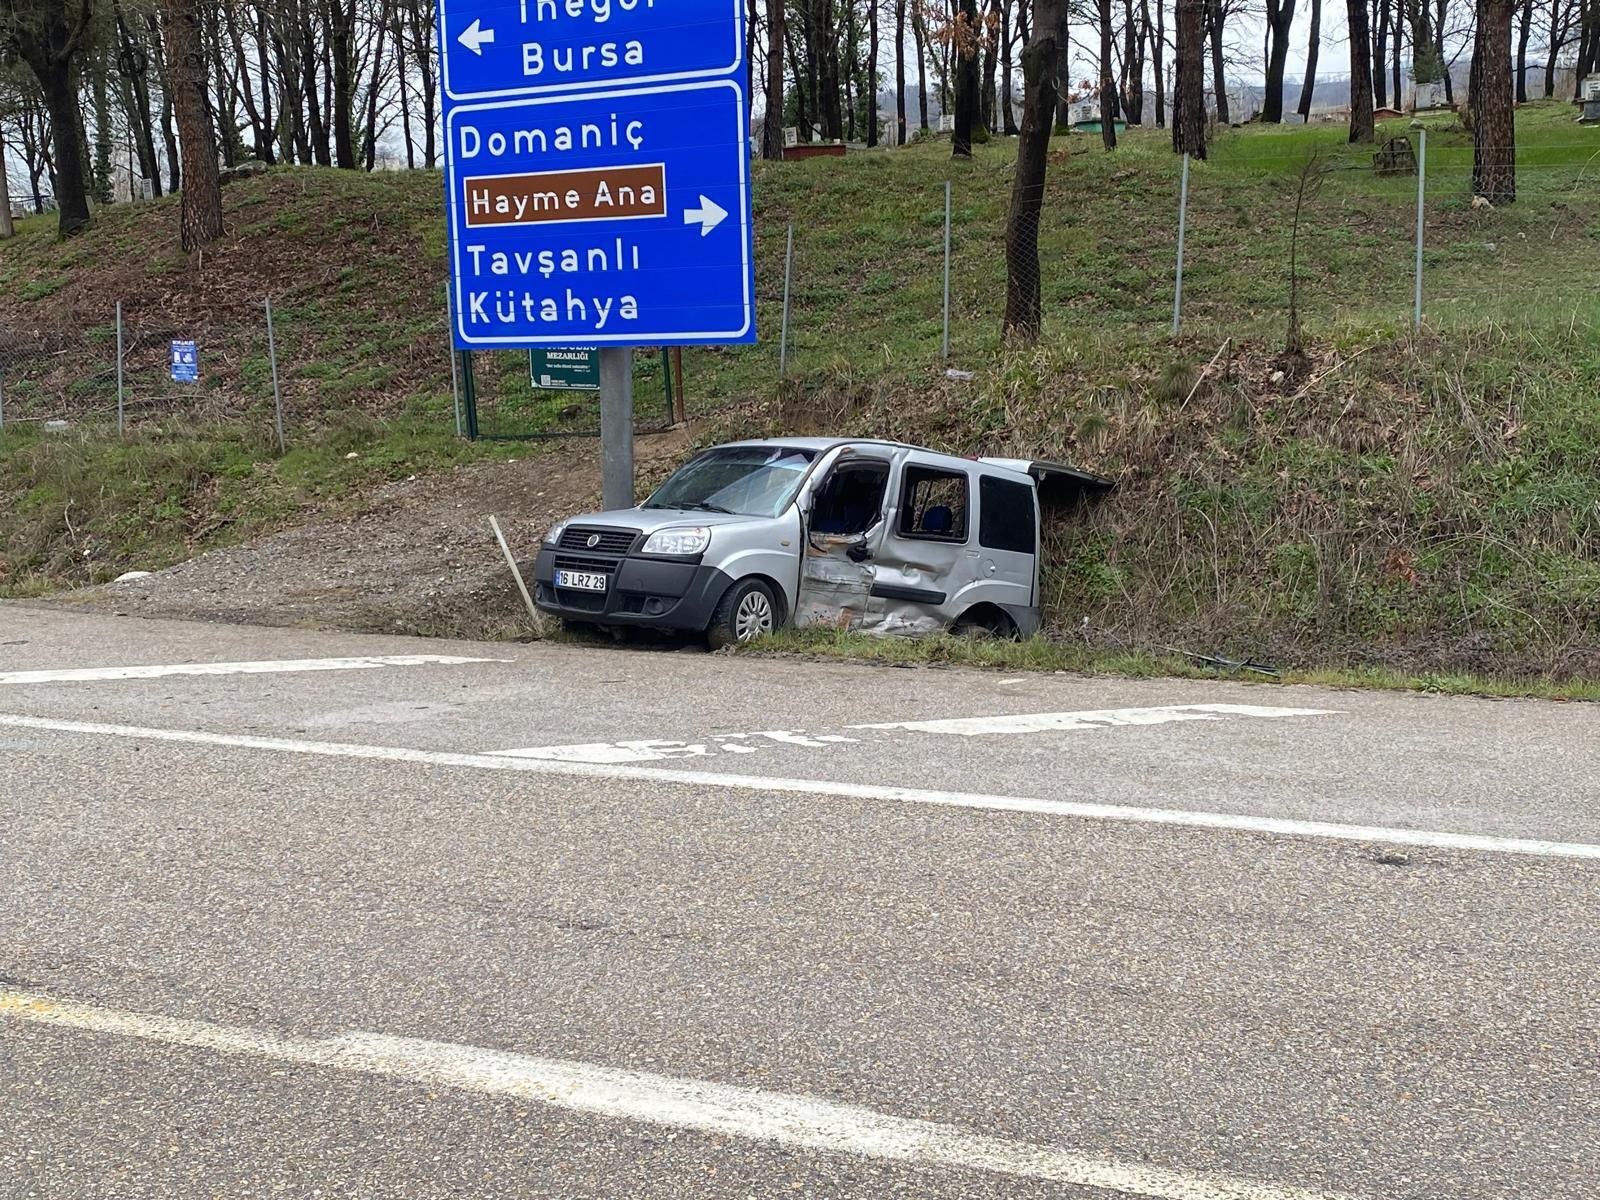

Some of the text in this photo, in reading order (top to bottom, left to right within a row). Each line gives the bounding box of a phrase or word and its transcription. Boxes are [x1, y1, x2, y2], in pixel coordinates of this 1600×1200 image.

[522, 40, 644, 76] Bursa
[460, 113, 644, 159] Domaniç
[472, 180, 656, 220] Hayme Ana
[466, 238, 640, 279] Tavşanlı
[469, 288, 639, 329] Kütahya
[546, 352, 589, 360] MEZARLIĞI
[560, 572, 605, 589] 16 LRZ 29
